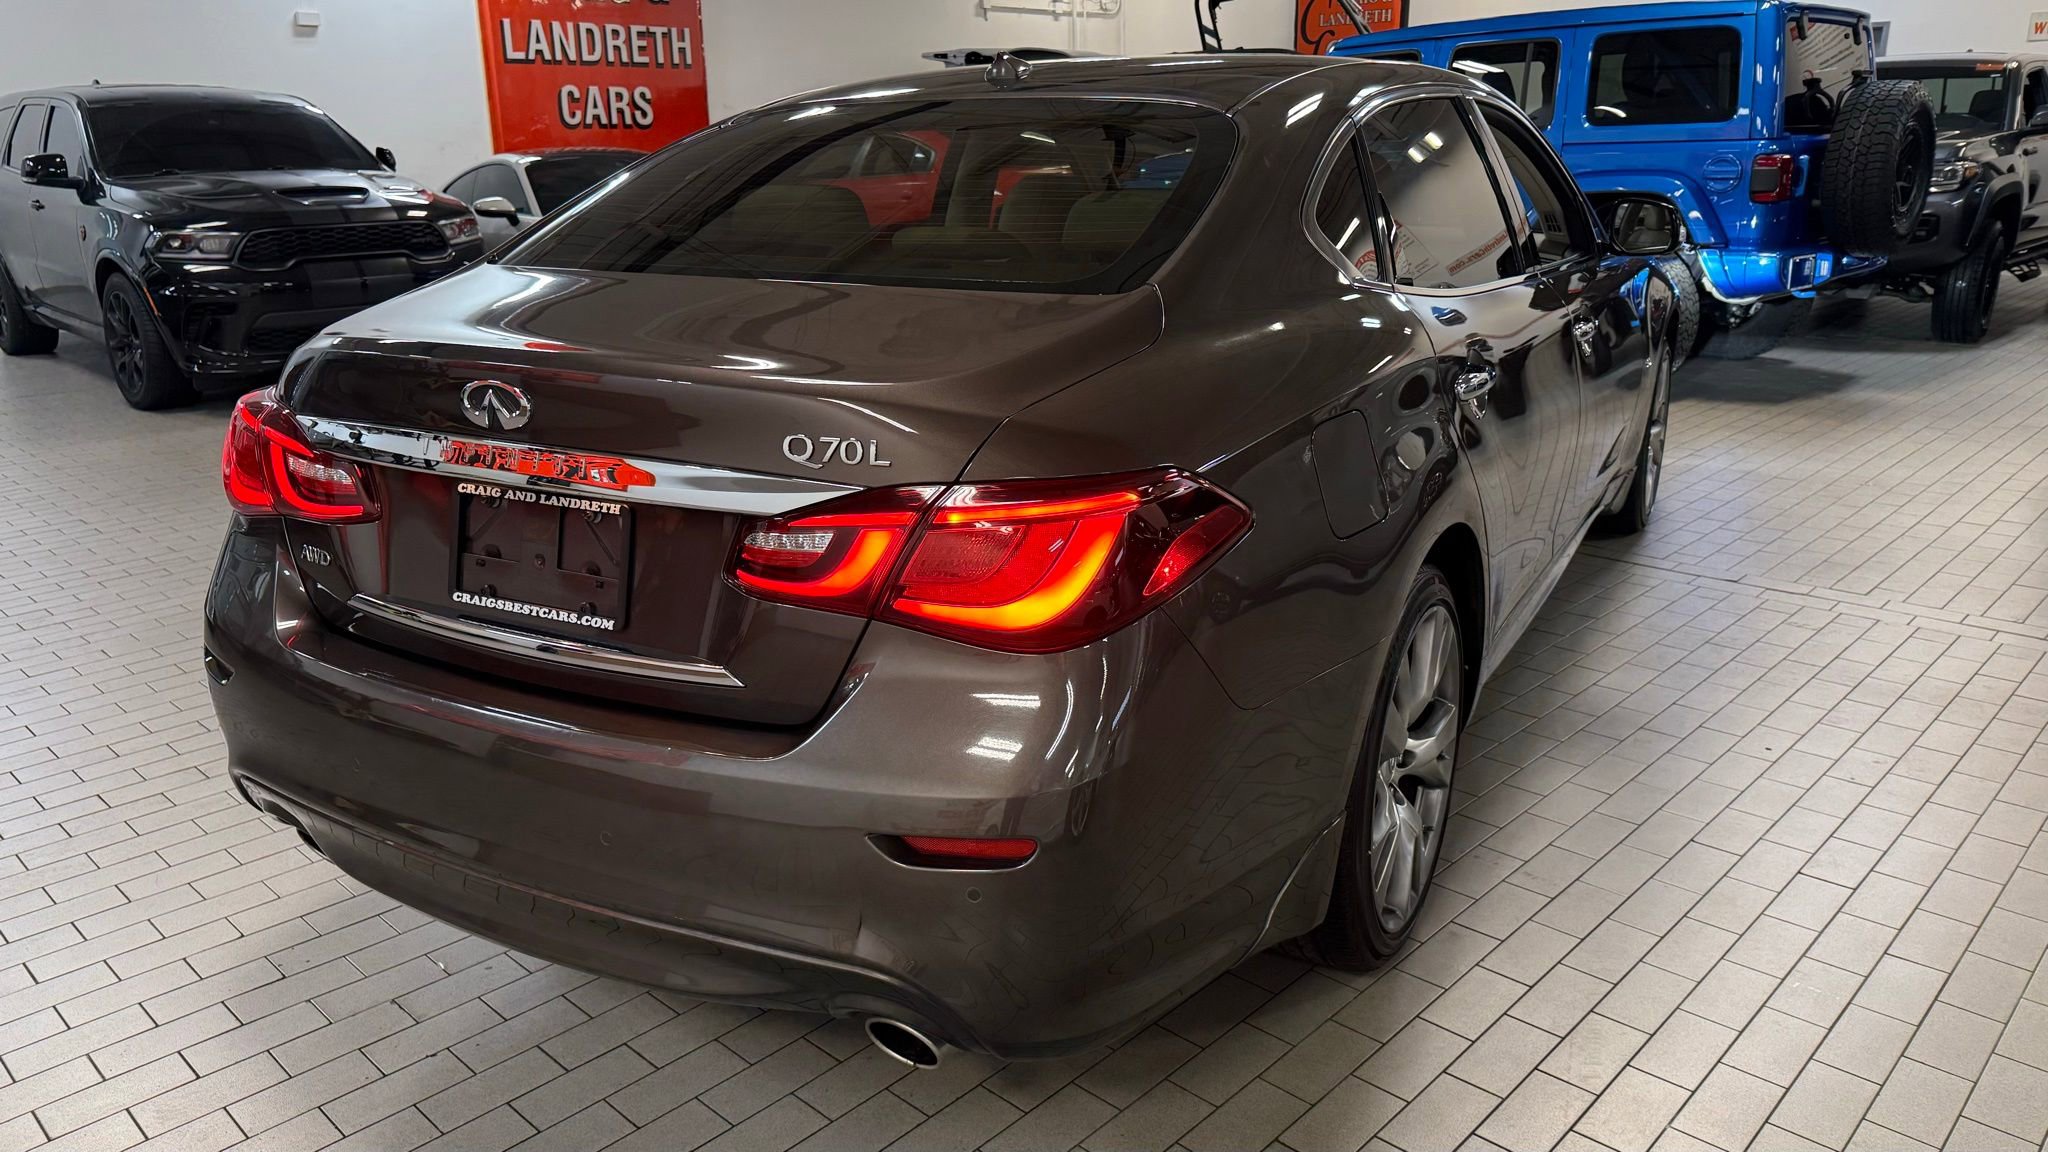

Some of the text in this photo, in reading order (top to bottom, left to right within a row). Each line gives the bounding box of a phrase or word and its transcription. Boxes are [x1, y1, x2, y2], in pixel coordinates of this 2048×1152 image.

[1319, 9, 1393, 27] LANETH
[501, 18, 692, 67] LANDRETH
[558, 84, 655, 129] CARS
[782, 433, 892, 470] Q70L
[457, 482, 622, 515] CRAIG AND LANDRETH
[300, 544, 331, 567] AWD
[452, 591, 615, 631] CRAIGSBESTCARS.COM
